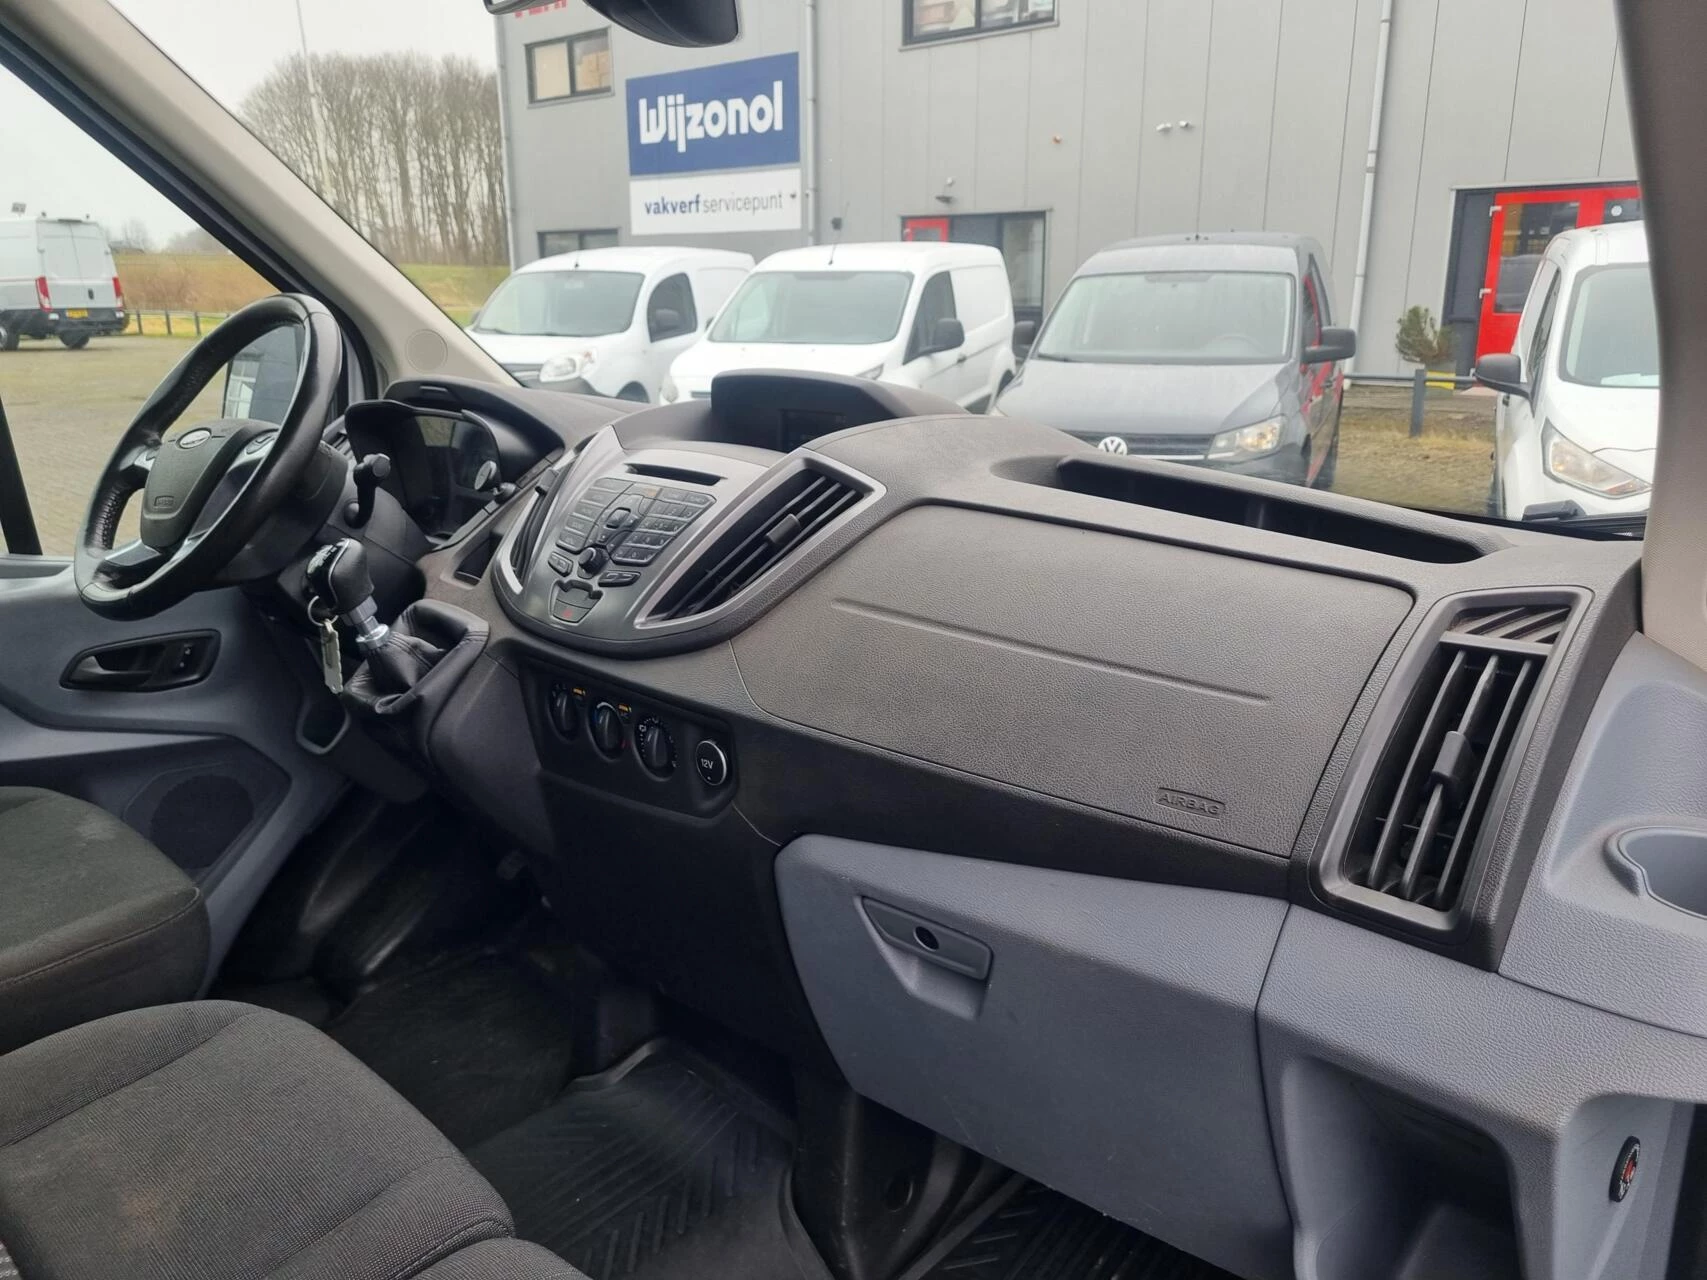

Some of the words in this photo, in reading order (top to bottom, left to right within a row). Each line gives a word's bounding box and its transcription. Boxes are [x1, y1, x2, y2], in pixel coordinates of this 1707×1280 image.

[638, 80, 783, 153] Wijzonol
[645, 194, 701, 215] vakverf
[703, 192, 783, 216] servicepunt
[700, 757, 715, 770] 12V
[1158, 792, 1220, 815] AIRBAG
